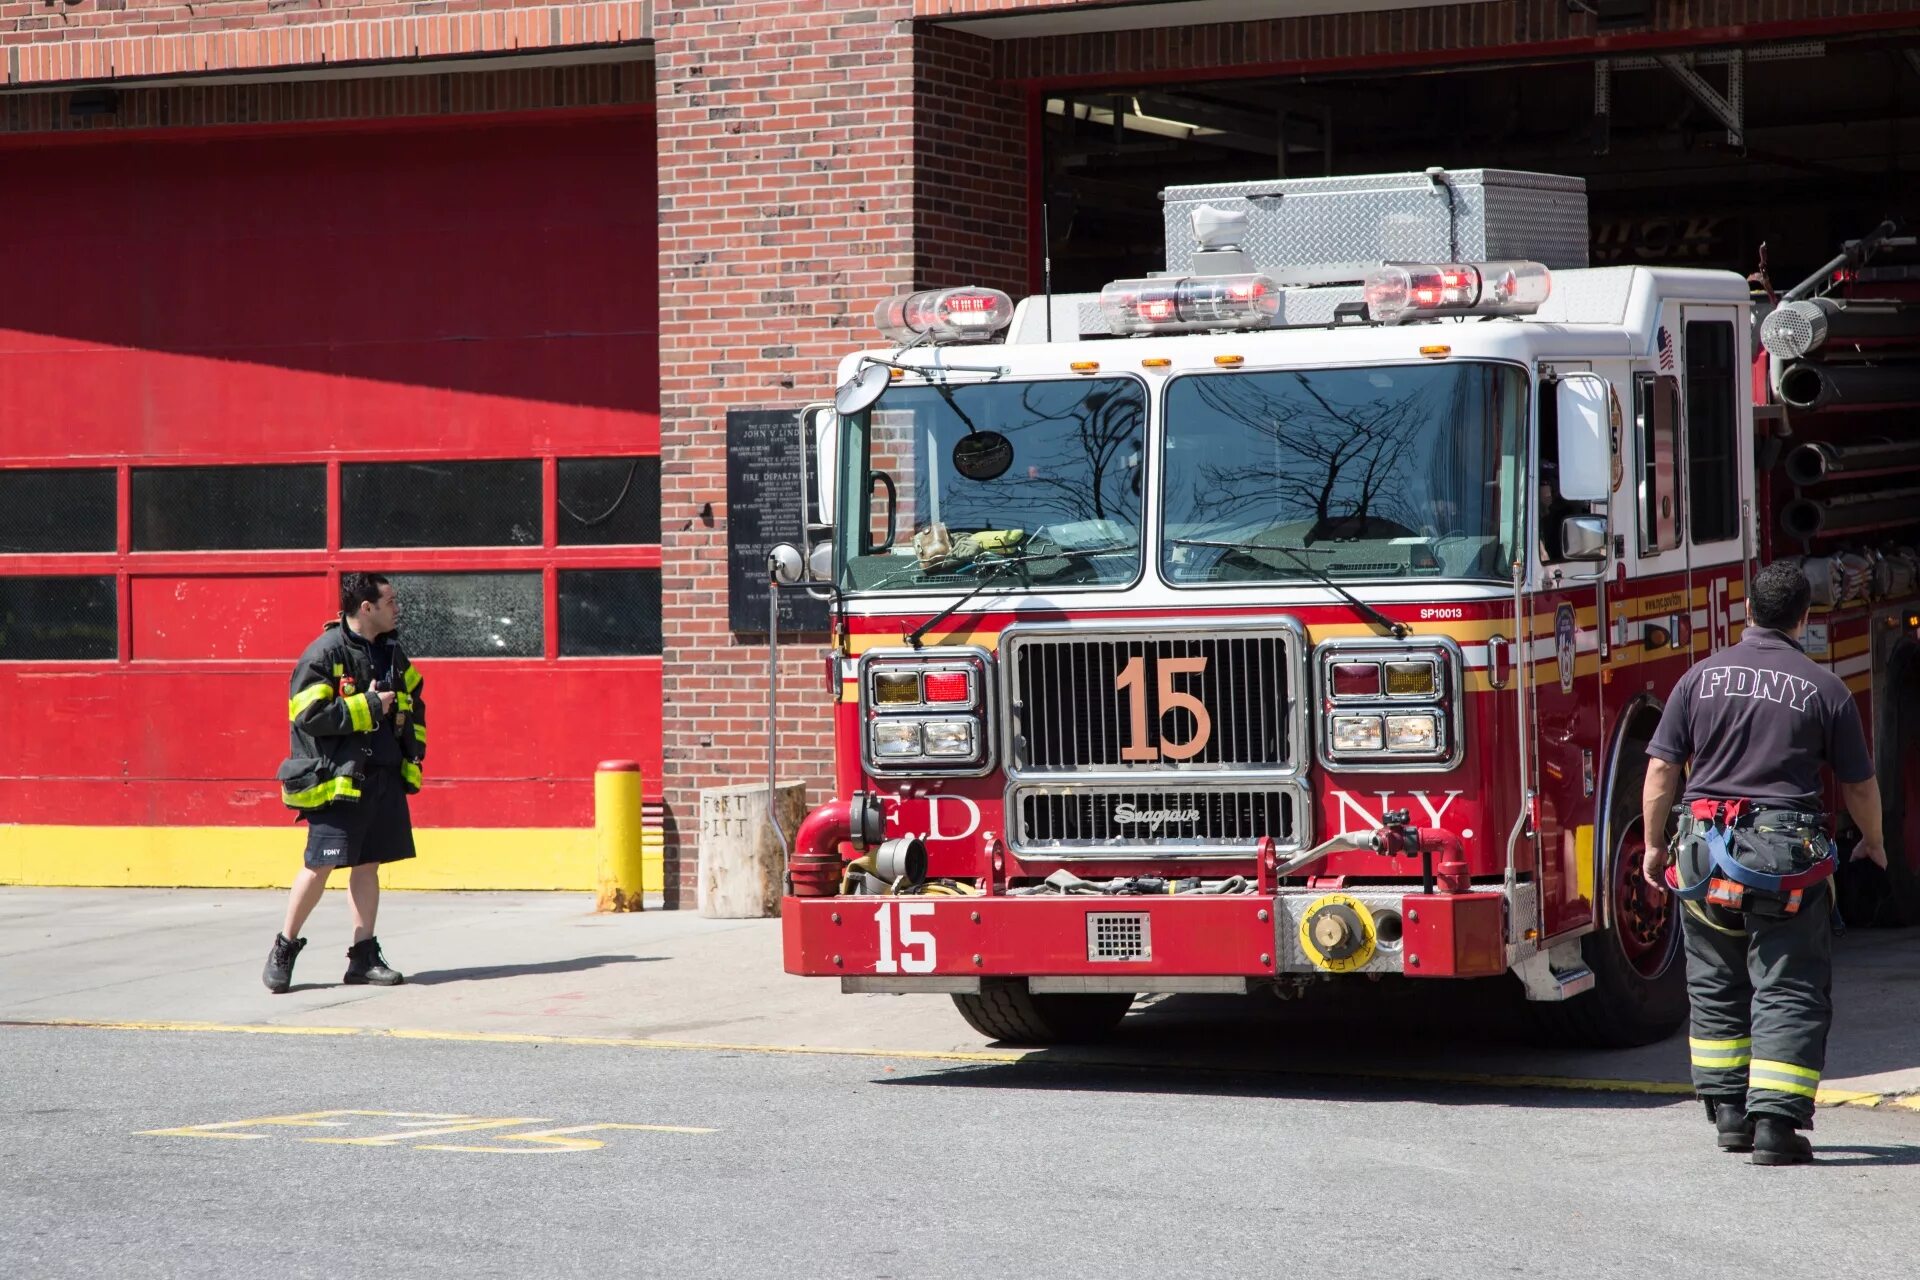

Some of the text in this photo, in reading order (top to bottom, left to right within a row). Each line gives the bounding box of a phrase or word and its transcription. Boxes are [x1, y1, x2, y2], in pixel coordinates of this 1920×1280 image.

[743, 430, 766, 438] JOHN
[778, 428, 814, 437] LINDAY
[743, 471, 815, 481] FIRE DEPARTMT
[1420, 608, 1462, 619] SP10013
[1709, 577, 1729, 655] 15
[1700, 665, 1818, 712] FDNY
[1116, 656, 1212, 761] 15
[704, 819, 748, 838] PITT
[1114, 803, 1200, 832] Seagrave
[323, 848, 341, 857] FDNY
[873, 902, 937, 974] 15
